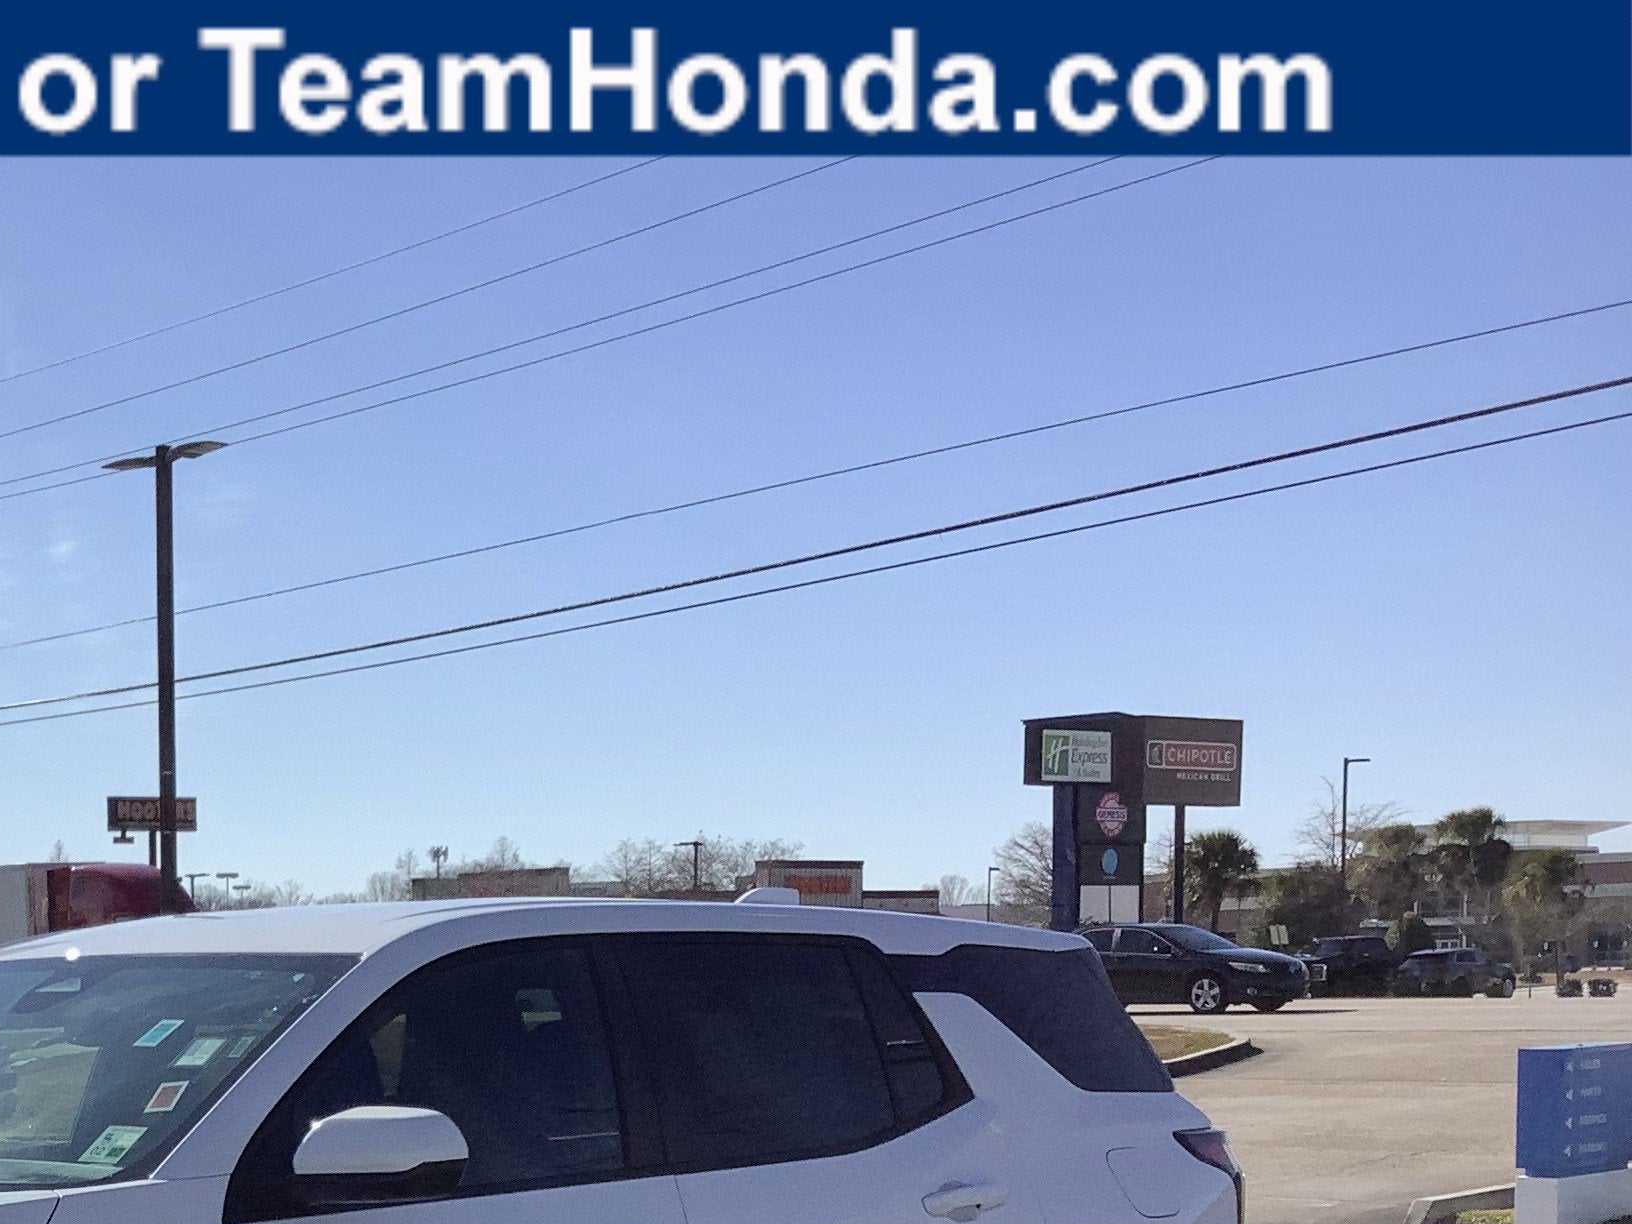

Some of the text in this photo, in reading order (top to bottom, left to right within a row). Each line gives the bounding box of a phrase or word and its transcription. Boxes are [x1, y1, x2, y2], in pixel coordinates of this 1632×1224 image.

[1071, 748, 1108, 766] Express
[1167, 747, 1232, 764] CHIPOTLE
[1176, 772, 1209, 781] MEXICAN
